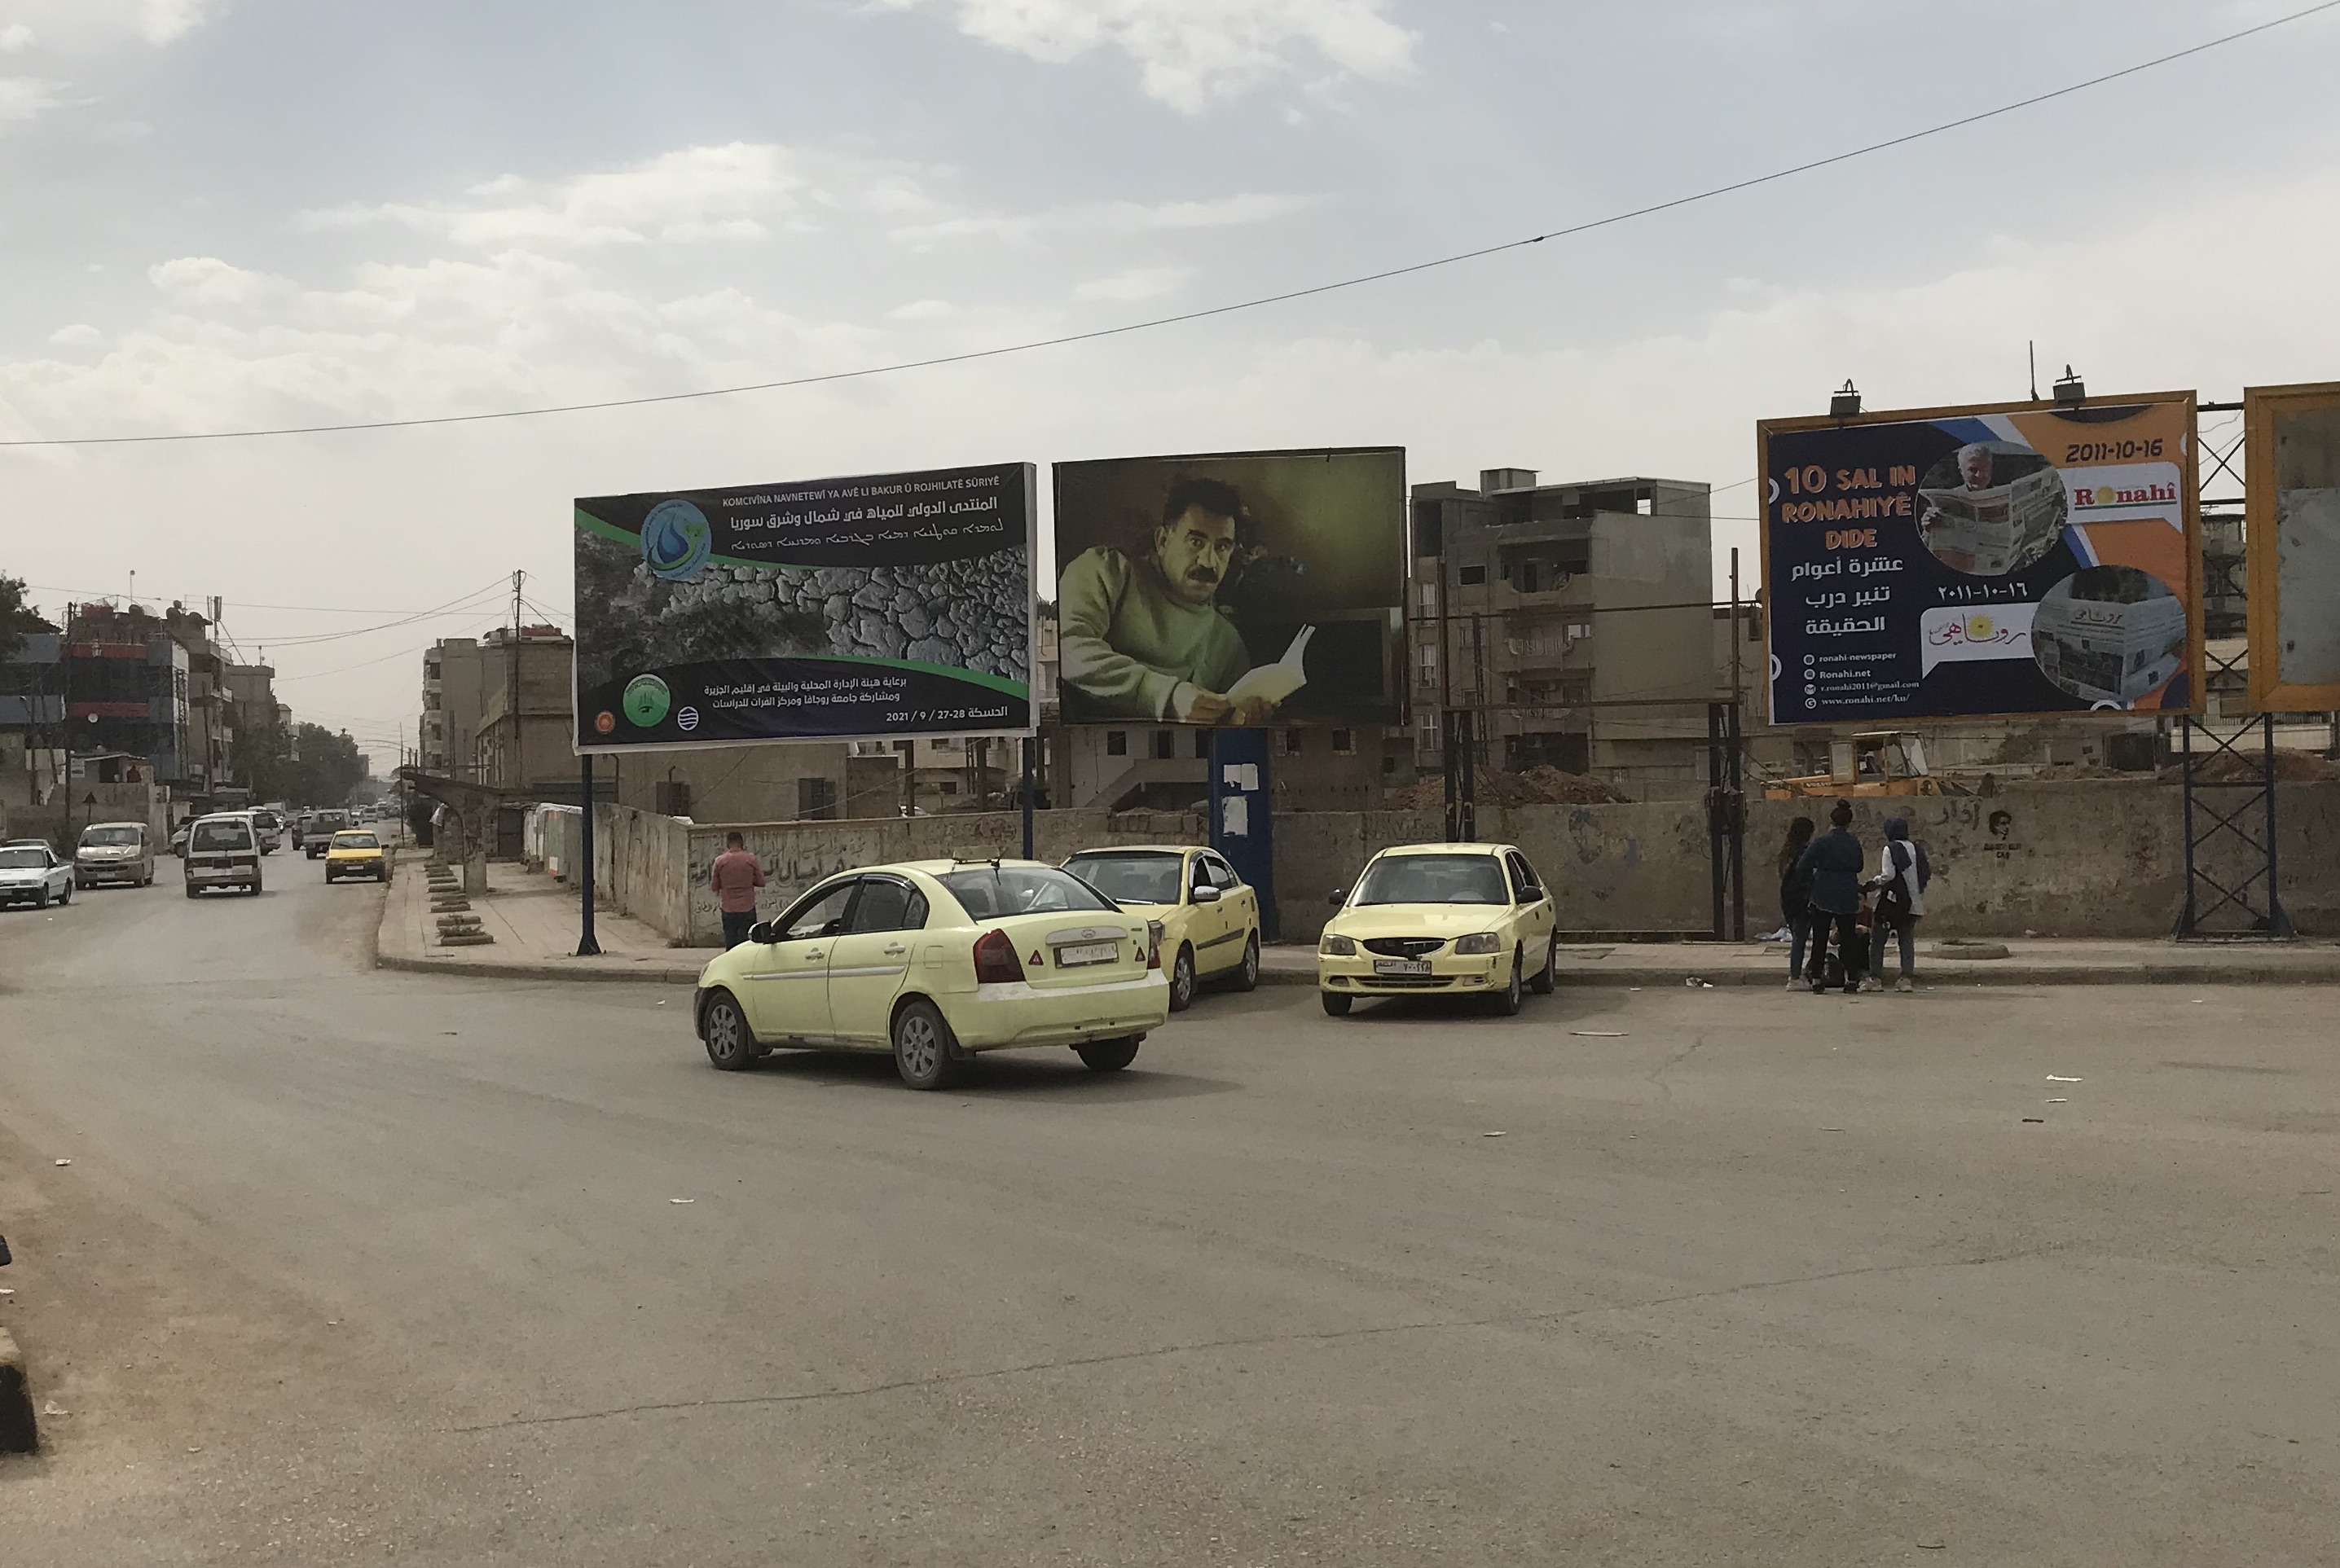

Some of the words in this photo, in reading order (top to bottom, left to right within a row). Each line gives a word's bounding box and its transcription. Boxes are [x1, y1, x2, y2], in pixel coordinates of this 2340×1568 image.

[2065, 437, 2163, 463] 2011-10-16
[1784, 464, 1828, 494] 10
[1836, 468, 1883, 491] SAL
[1889, 464, 1916, 487] IN
[722, 494, 772, 507] KOMCIVÎNA
[773, 489, 826, 503] NAVNETEWÎ
[827, 490, 840, 499] YA
[841, 487, 859, 498] AVÊ
[861, 487, 869, 496] LI
[871, 485, 903, 496] BAKUR
[904, 482, 912, 493] Û
[914, 477, 964, 493] ROJHILATÊ
[965, 475, 1000, 488] SÛRIYÊ
[907, 500, 946, 517] الدولي
[949, 496, 997, 514] المنتدى
[1781, 490, 1912, 524] RONAHIYÊ
[803, 507, 840, 525] شمال
[843, 507, 862, 522] في
[866, 504, 904, 520] للمياه
[730, 516, 763, 531] سوريا
[767, 510, 801, 529] وشرق
[1824, 528, 1878, 551] DIDE
[1791, 556, 1841, 582] أعوام
[1849, 556, 1903, 578] عشرة
[1805, 591, 1846, 608] درب
[1851, 586, 1890, 608] تنير
[1806, 616, 1885, 637] الحقيقة
[1819, 652, 1897, 663] ronahi-newspaper
[1819, 669, 1872, 679] Ronahi.net
[757, 683, 771, 693] في
[772, 681, 798, 693] والبيئة
[800, 679, 831, 692] المحلية
[833, 678, 859, 690] الإدارة
[860, 678, 881, 689] هيئة
[882, 676, 907, 687] برعاية
[704, 684, 730, 696] الجزيرة
[859, 690, 900, 703] ومشاركة
[712, 697, 749, 709] للدراسات
[750, 696, 775, 708] الفرات
[776, 696, 802, 708] ومركز
[831, 693, 858, 705] جامعة
[1821, 693, 1911, 705] www.ronahi.net/ku/
[886, 712, 908, 722] 2021
[919, 711, 926, 720] 9
[937, 709, 965, 719] 27-28
[968, 705, 1008, 718] الحسكة
